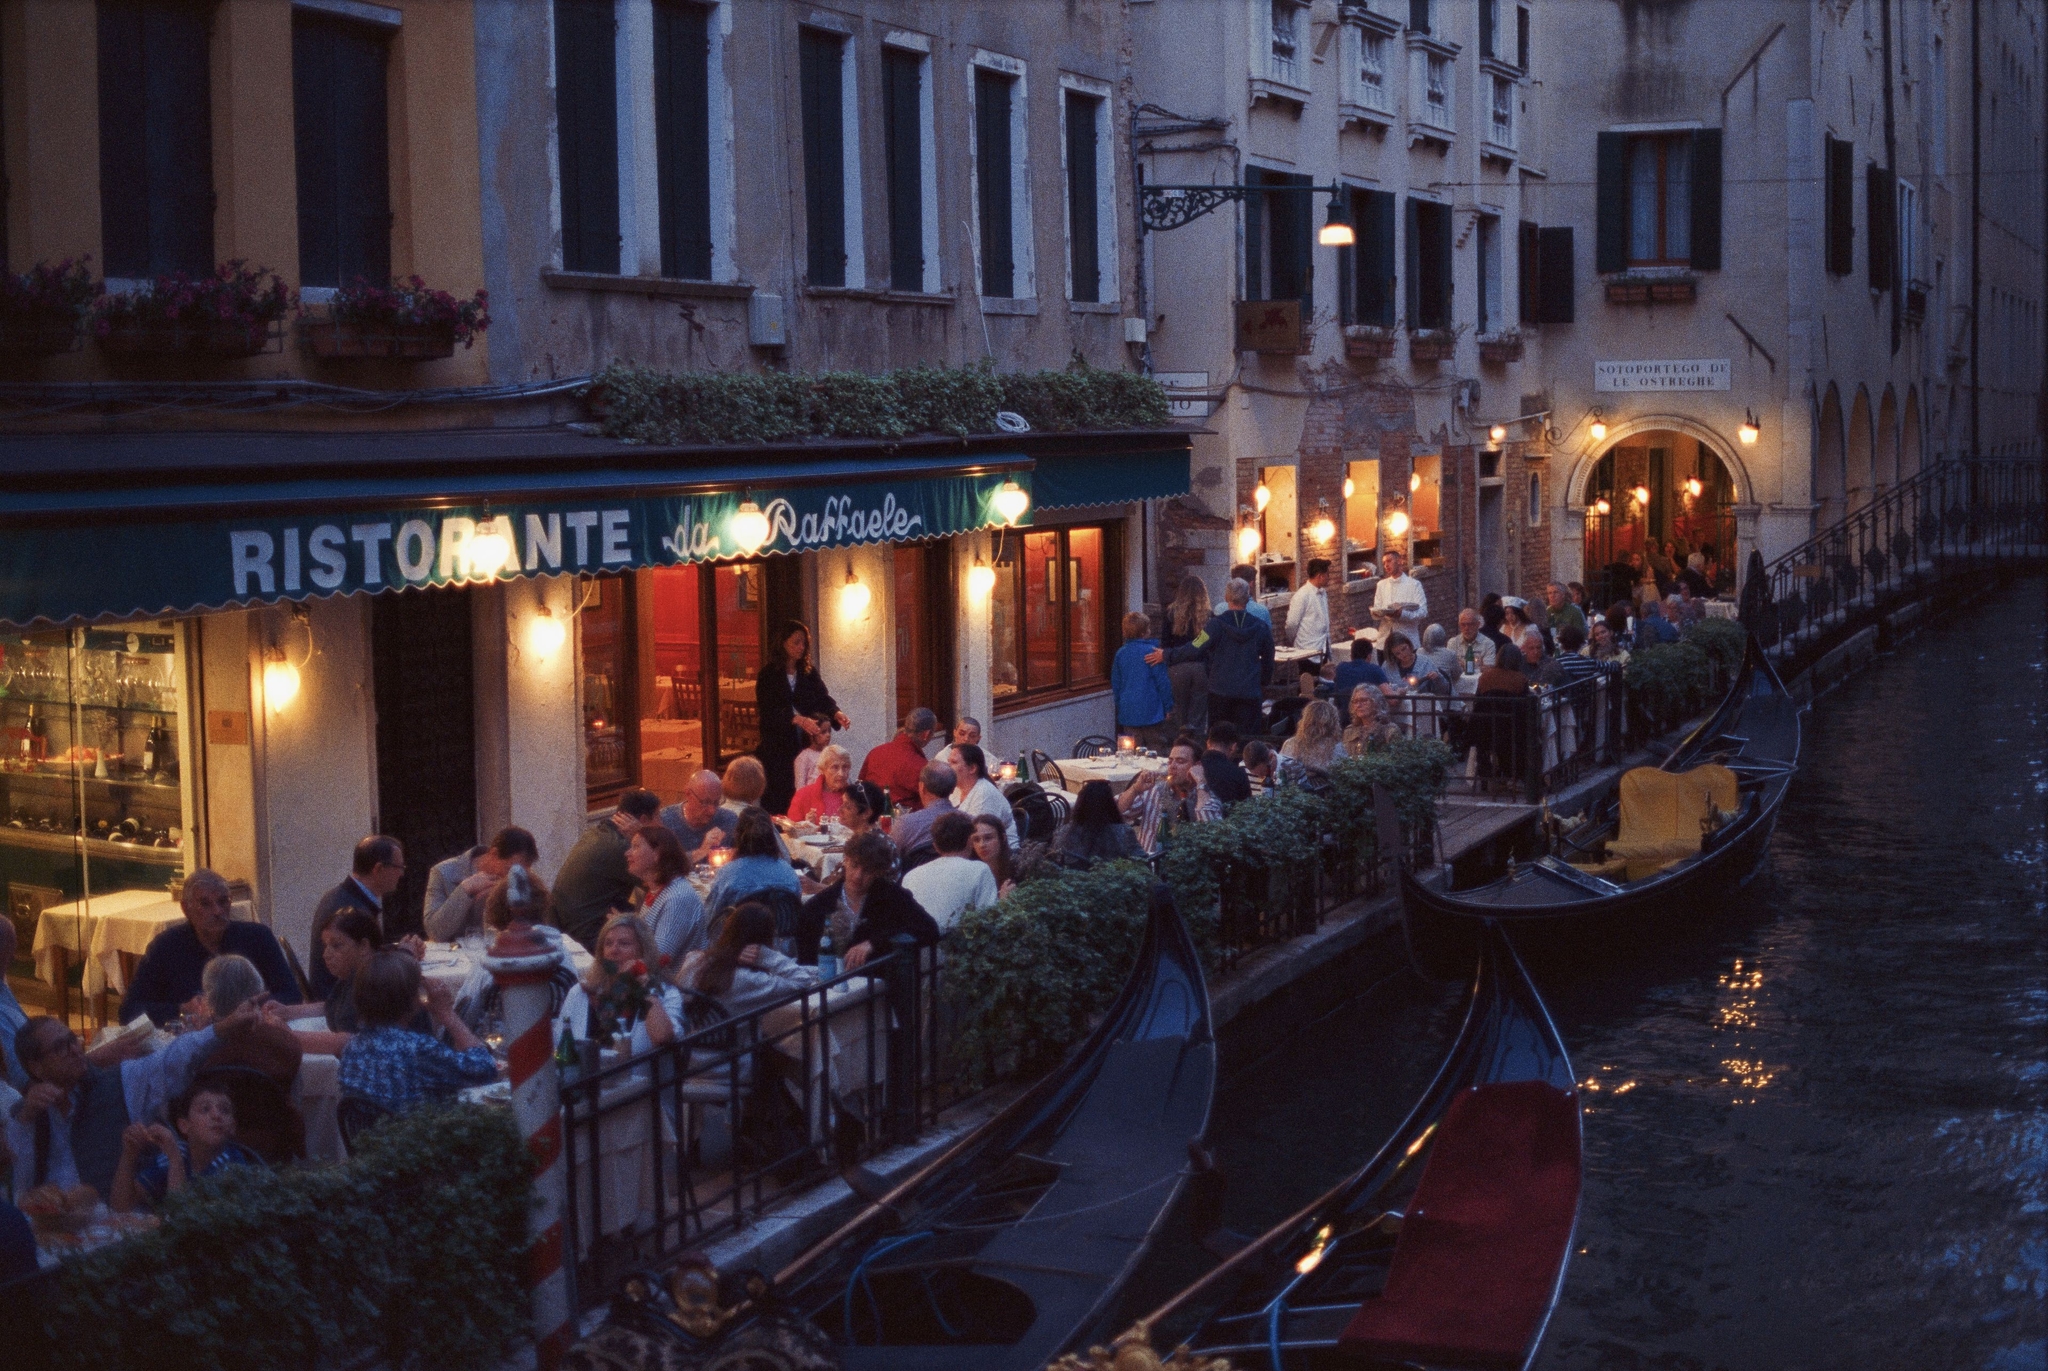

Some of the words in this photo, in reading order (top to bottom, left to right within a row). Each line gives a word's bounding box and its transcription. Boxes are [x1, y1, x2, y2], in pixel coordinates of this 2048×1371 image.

[1599, 363, 1700, 374] SOTOPORTEGO
[1612, 377, 1630, 387] LE
[1639, 376, 1715, 387] OSTREGHE
[230, 509, 633, 595] RISTORANTE
[662, 505, 720, 557] da
[760, 492, 922, 546] Raffaele
